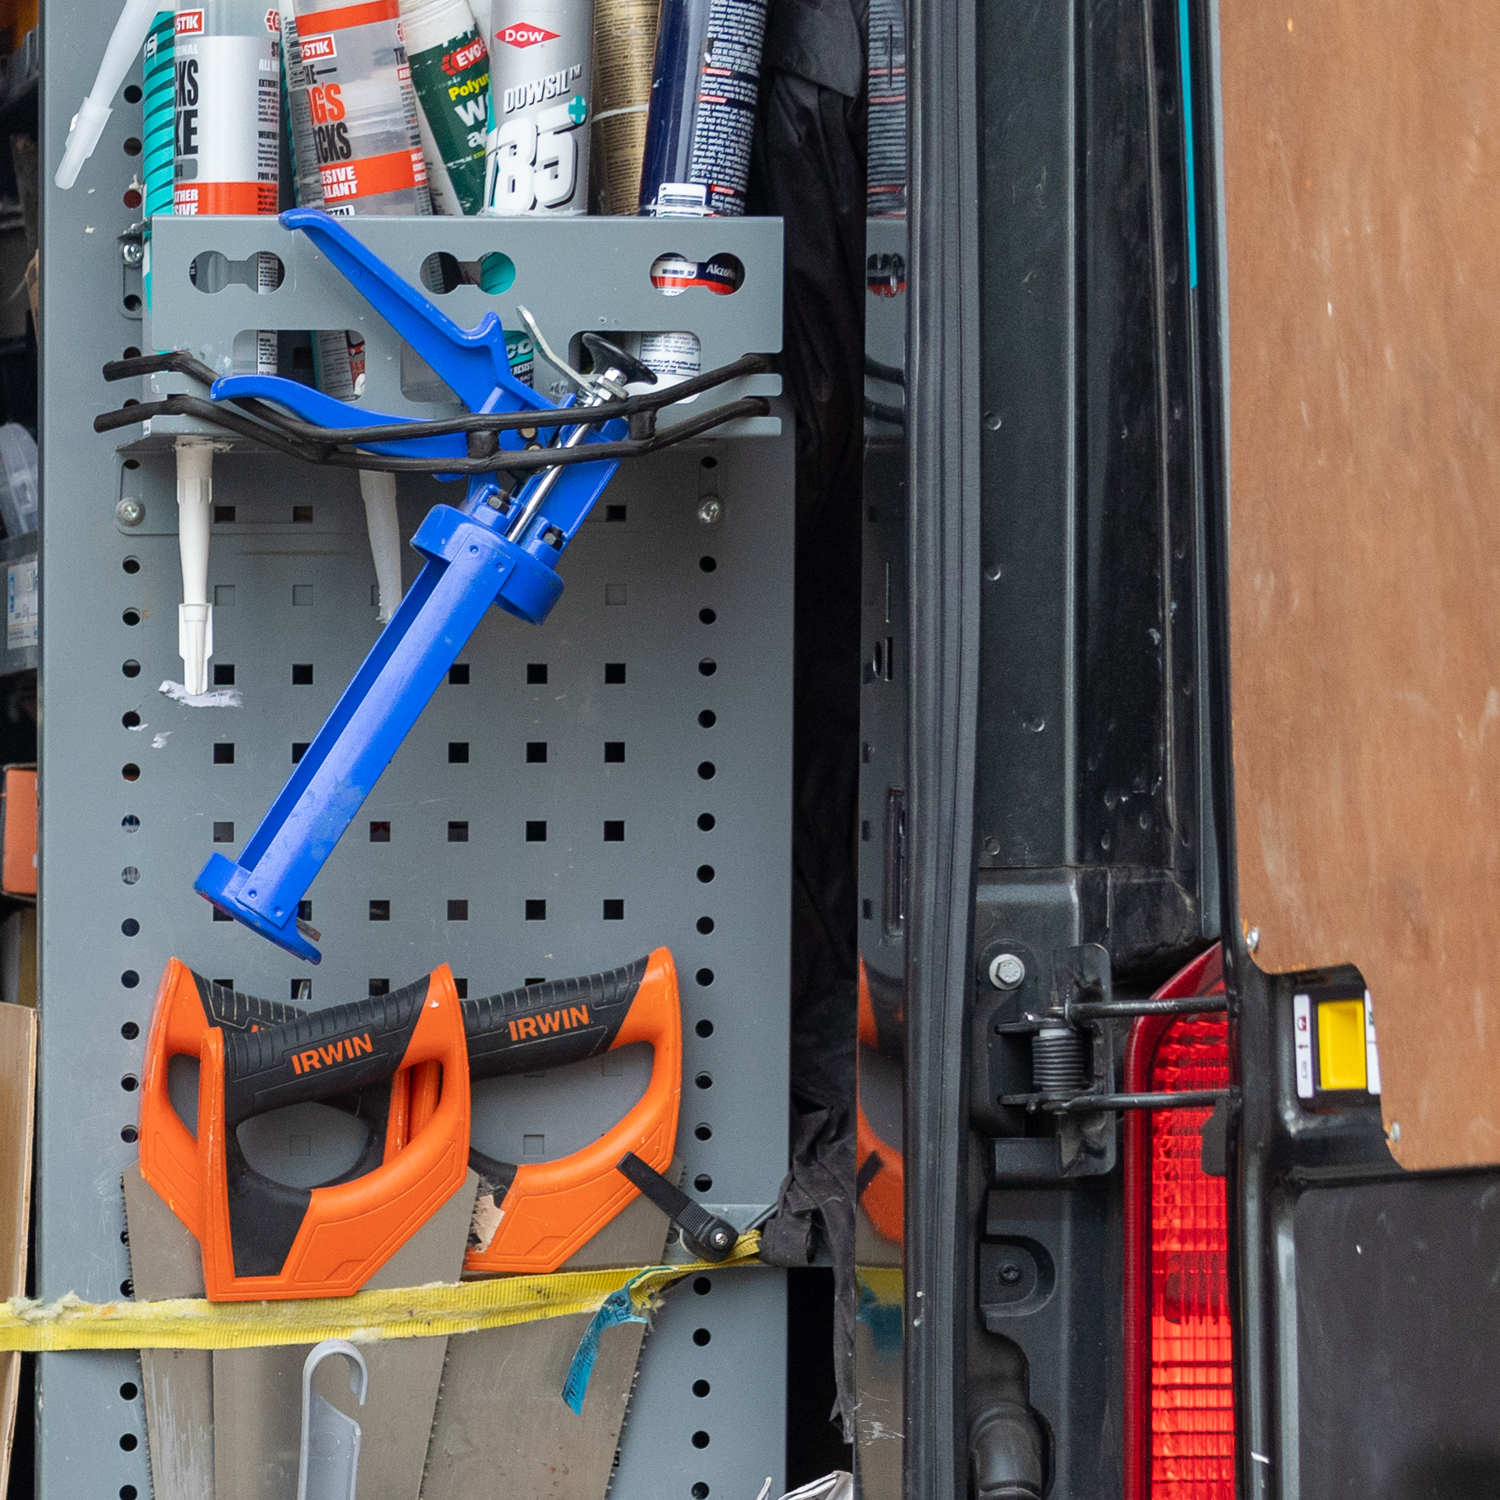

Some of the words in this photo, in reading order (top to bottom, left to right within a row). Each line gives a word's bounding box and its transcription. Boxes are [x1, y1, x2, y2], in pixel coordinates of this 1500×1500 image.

[175, 59, 199, 107] KS
[313, 122, 352, 163] CKS
[508, 1004, 592, 1042] IRWIN
[291, 1032, 374, 1076] IRWIN
